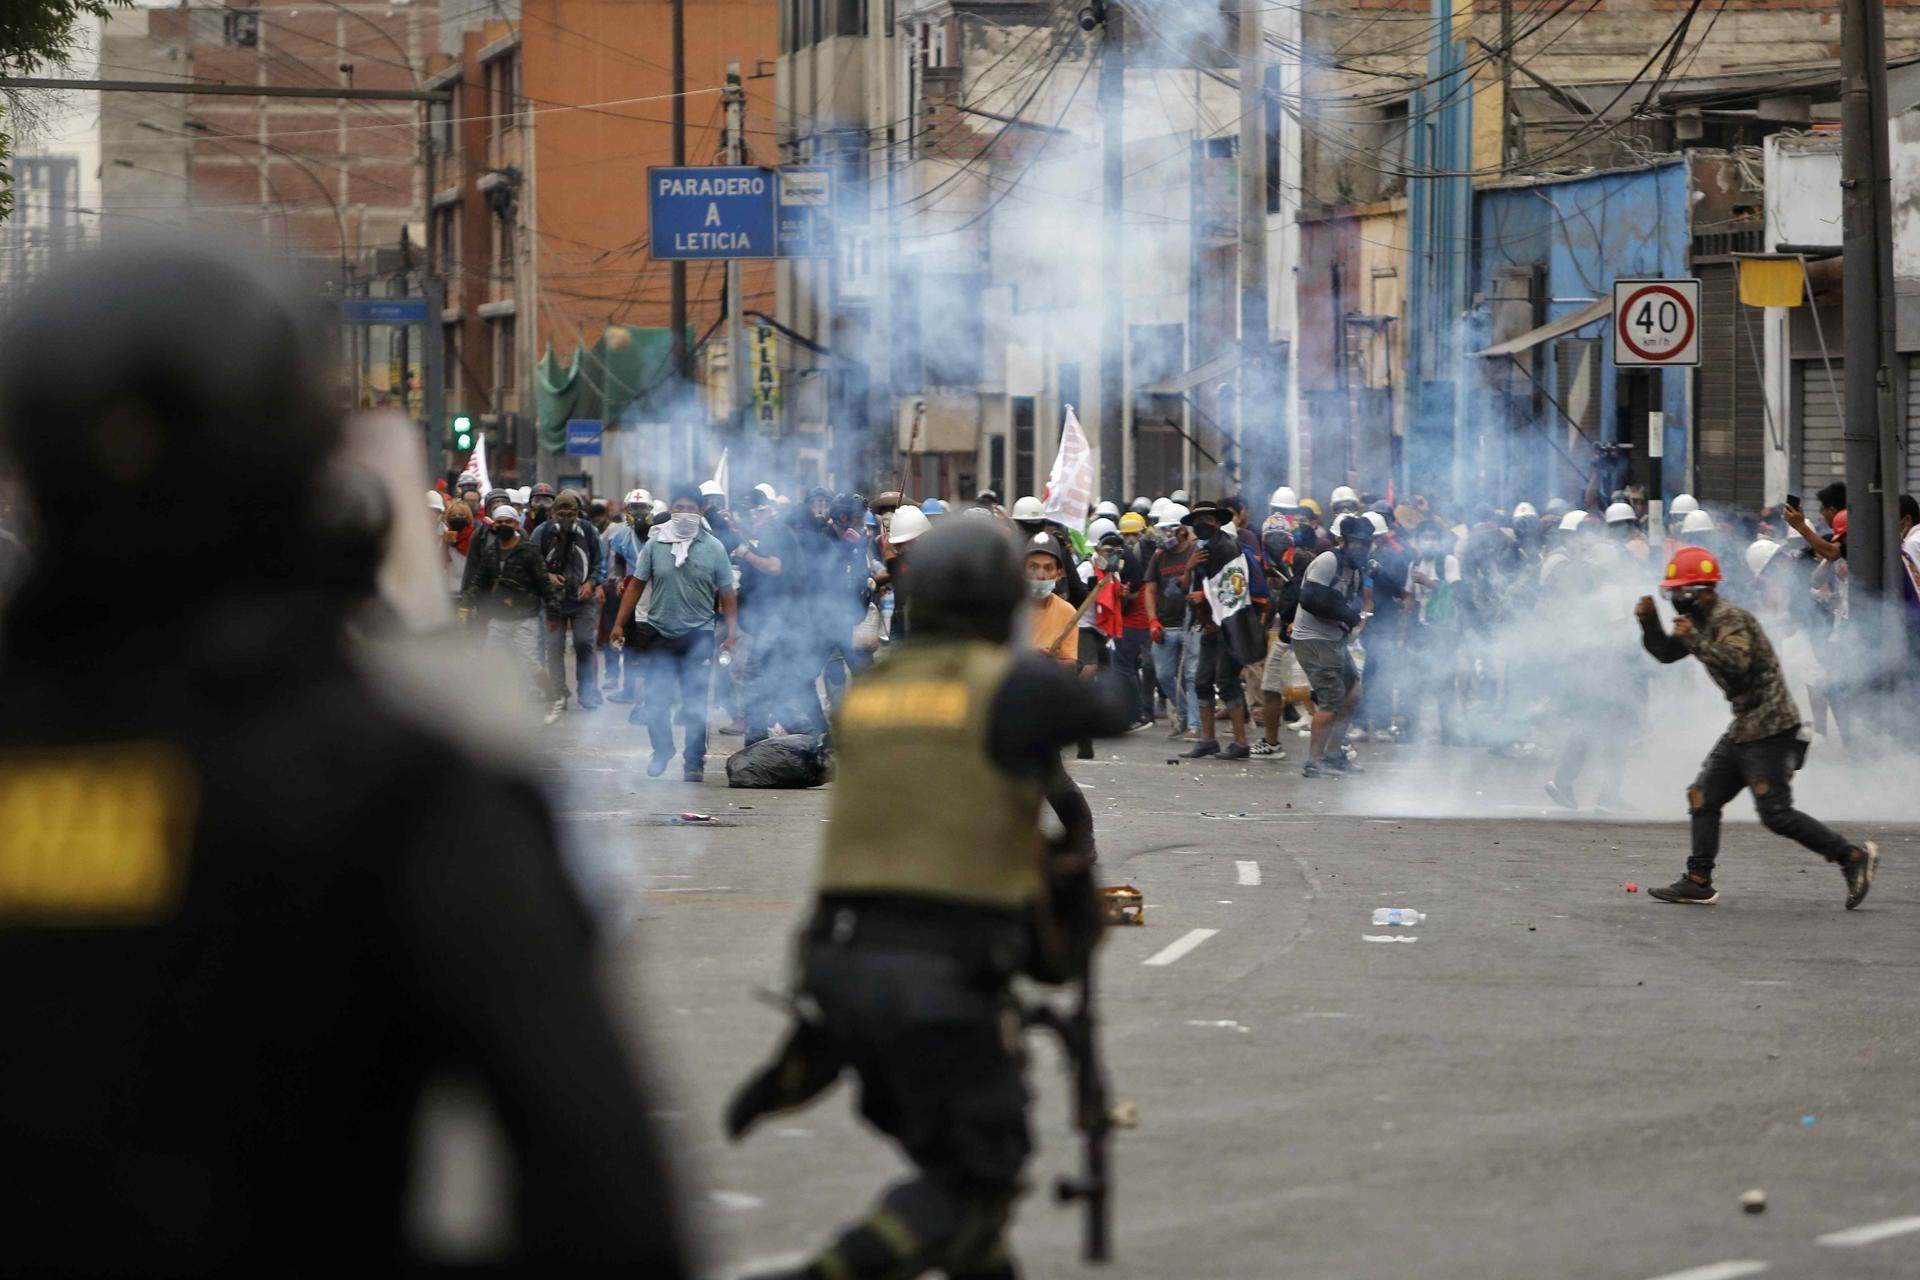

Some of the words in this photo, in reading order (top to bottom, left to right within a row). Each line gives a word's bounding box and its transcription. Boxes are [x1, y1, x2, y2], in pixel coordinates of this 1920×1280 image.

[659, 178, 765, 197] PARADERO
[705, 202, 721, 227] A
[675, 232, 751, 250] LETICIA
[1636, 301, 1677, 334] 40
[758, 327, 774, 421] PLAYA
